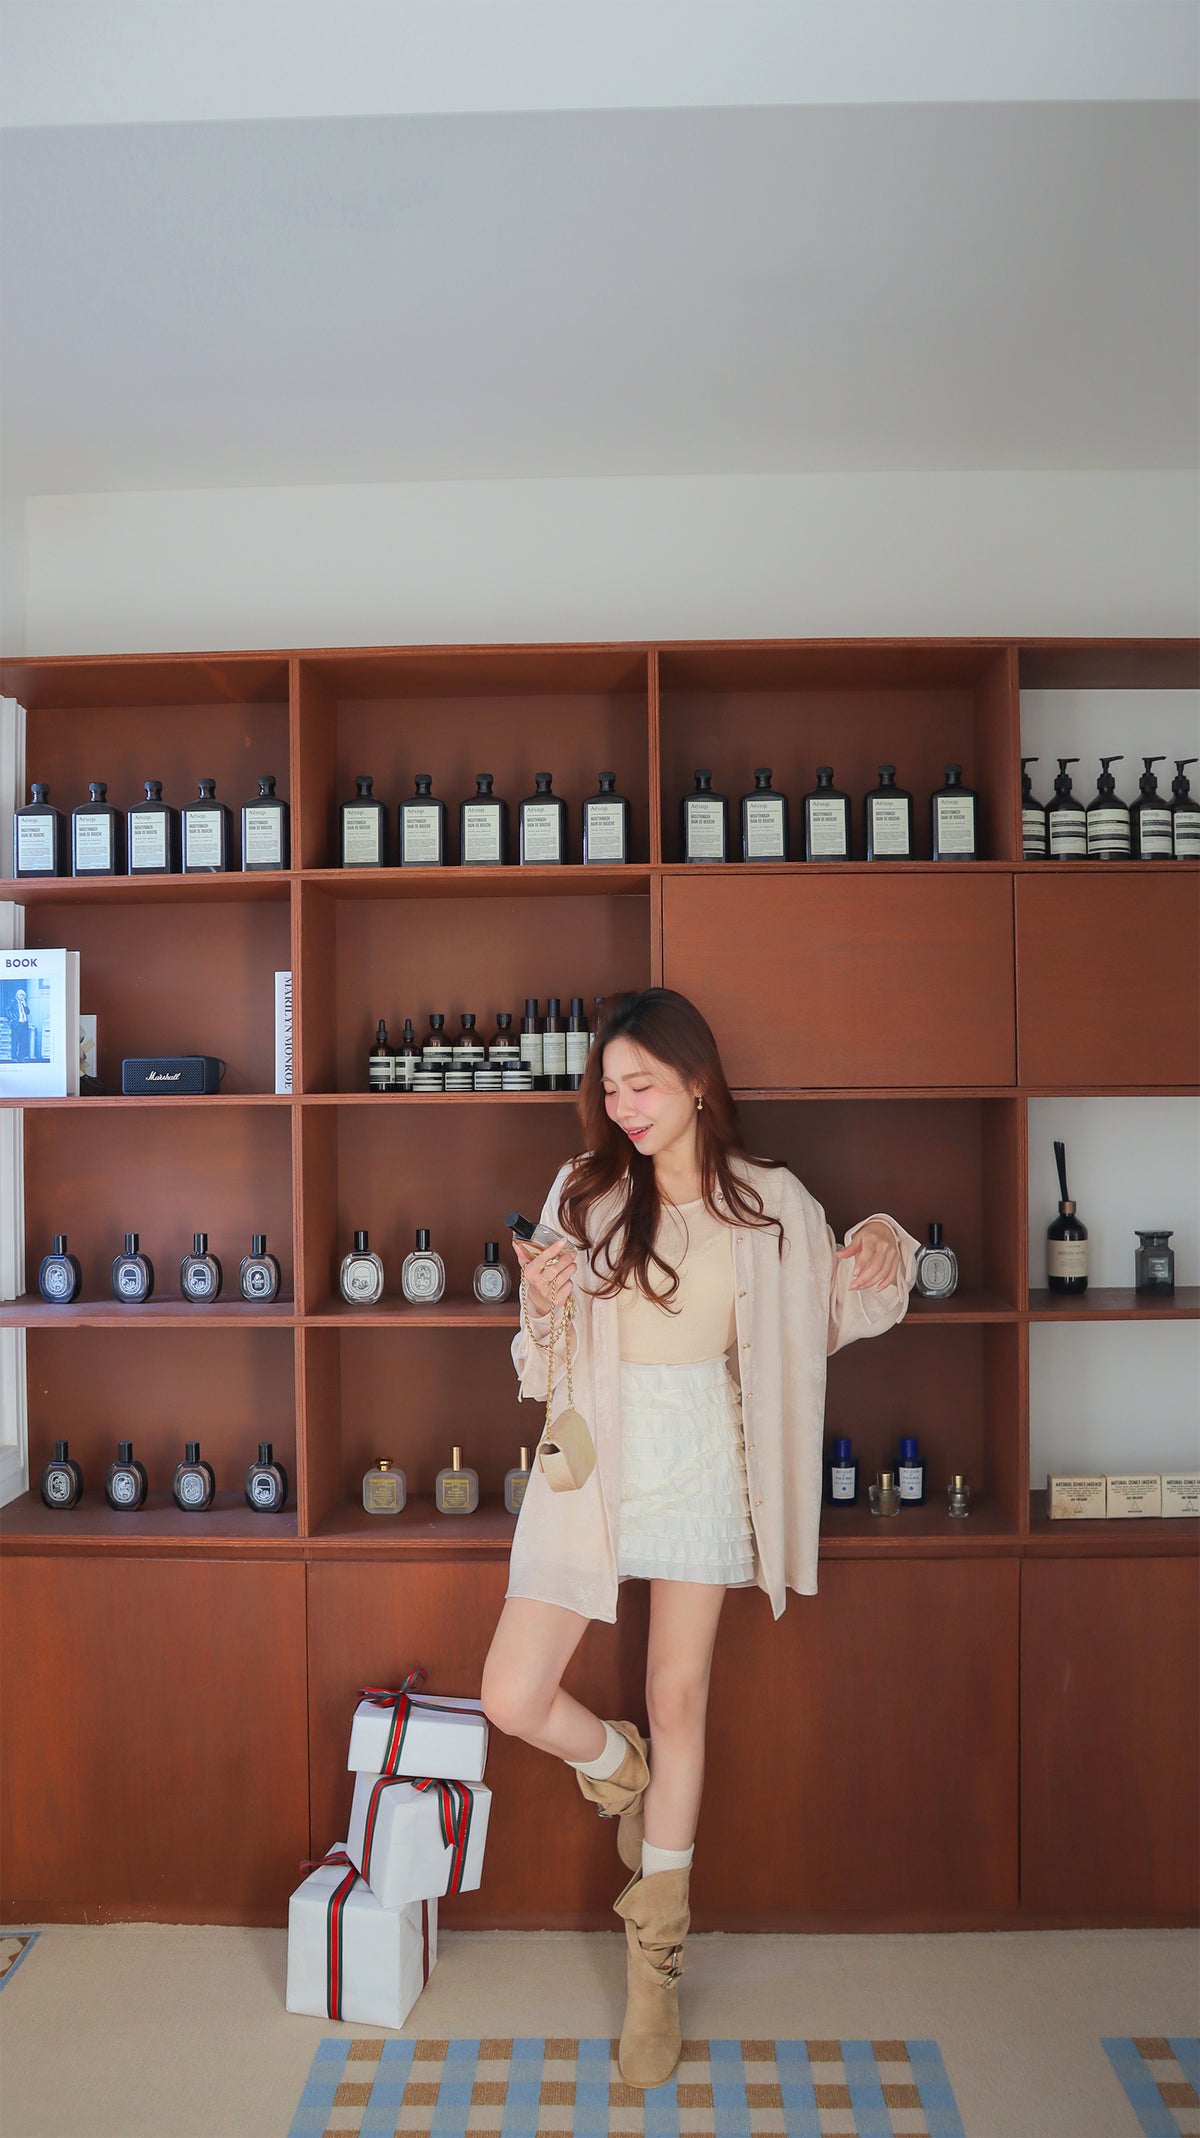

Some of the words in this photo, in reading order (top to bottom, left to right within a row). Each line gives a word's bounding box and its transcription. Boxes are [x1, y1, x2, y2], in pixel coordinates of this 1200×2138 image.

[5, 958, 38, 968] BOOK
[284, 977, 292, 1033] MARILYN
[145, 1070, 182, 1081] Marshall
[284, 1036, 293, 1089] MONROE
